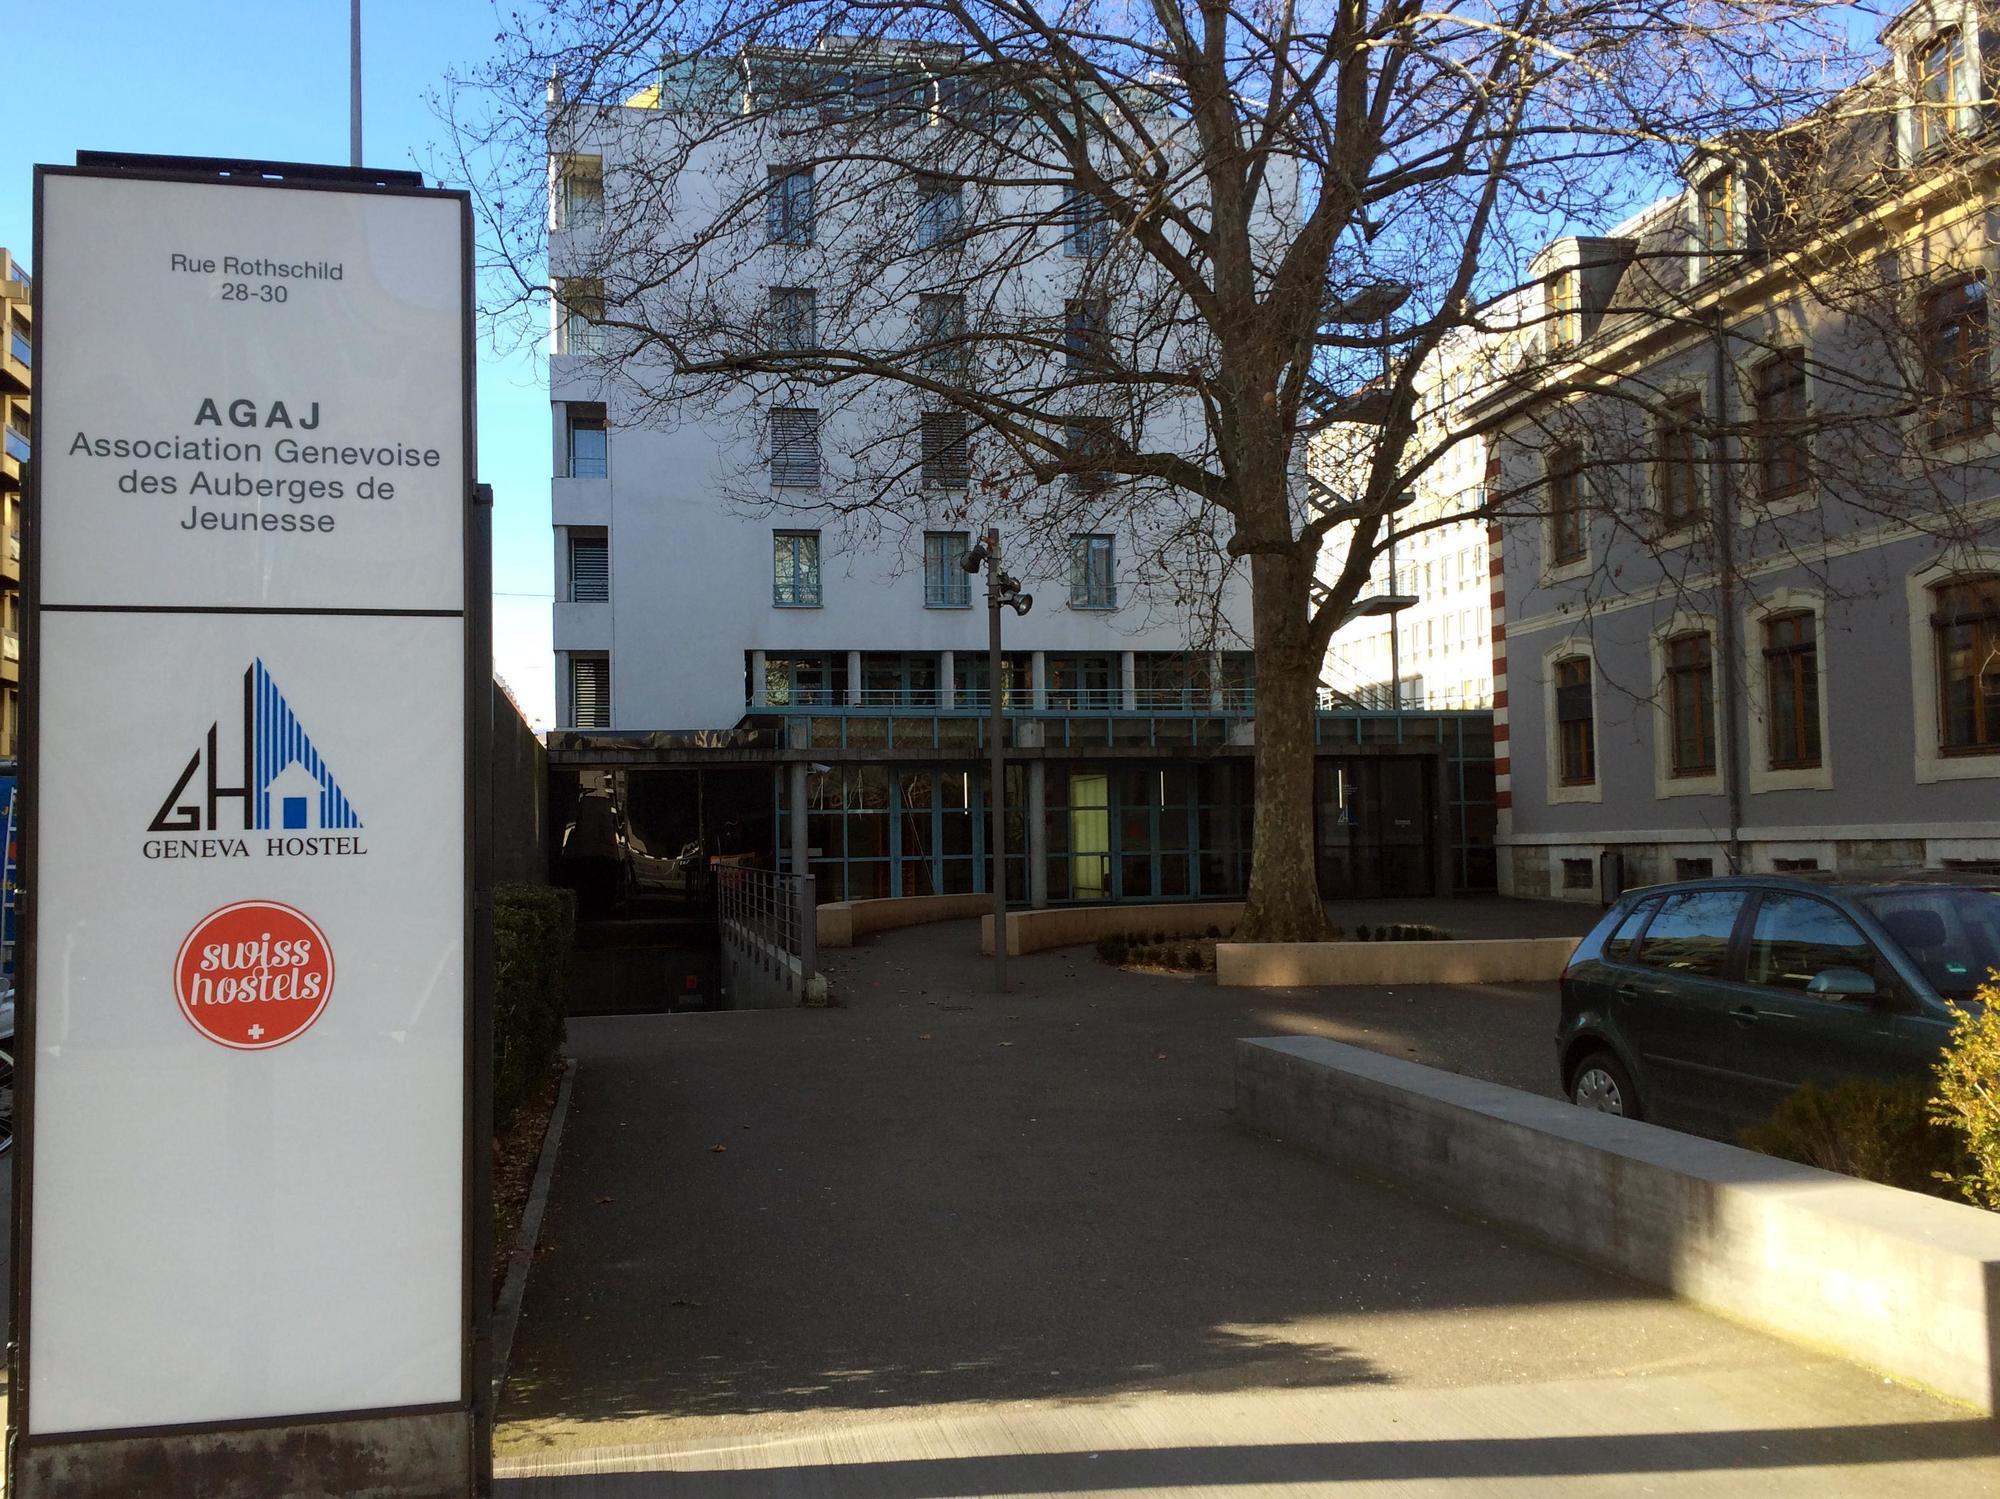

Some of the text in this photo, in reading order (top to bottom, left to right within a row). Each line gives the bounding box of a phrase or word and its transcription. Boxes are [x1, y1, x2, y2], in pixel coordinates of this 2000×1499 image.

[171, 253, 344, 281] Rue Rothschild
[221, 282, 289, 304] 28-30
[193, 397, 321, 431] AGAJ
[68, 431, 442, 468] Association Genevoise
[118, 469, 396, 504] des Auberges de
[180, 505, 336, 533] Jeunesse
[142, 836, 368, 860] GENEVA HOSTEL
[200, 932, 312, 972] swiss
[190, 965, 322, 1006] hostels
